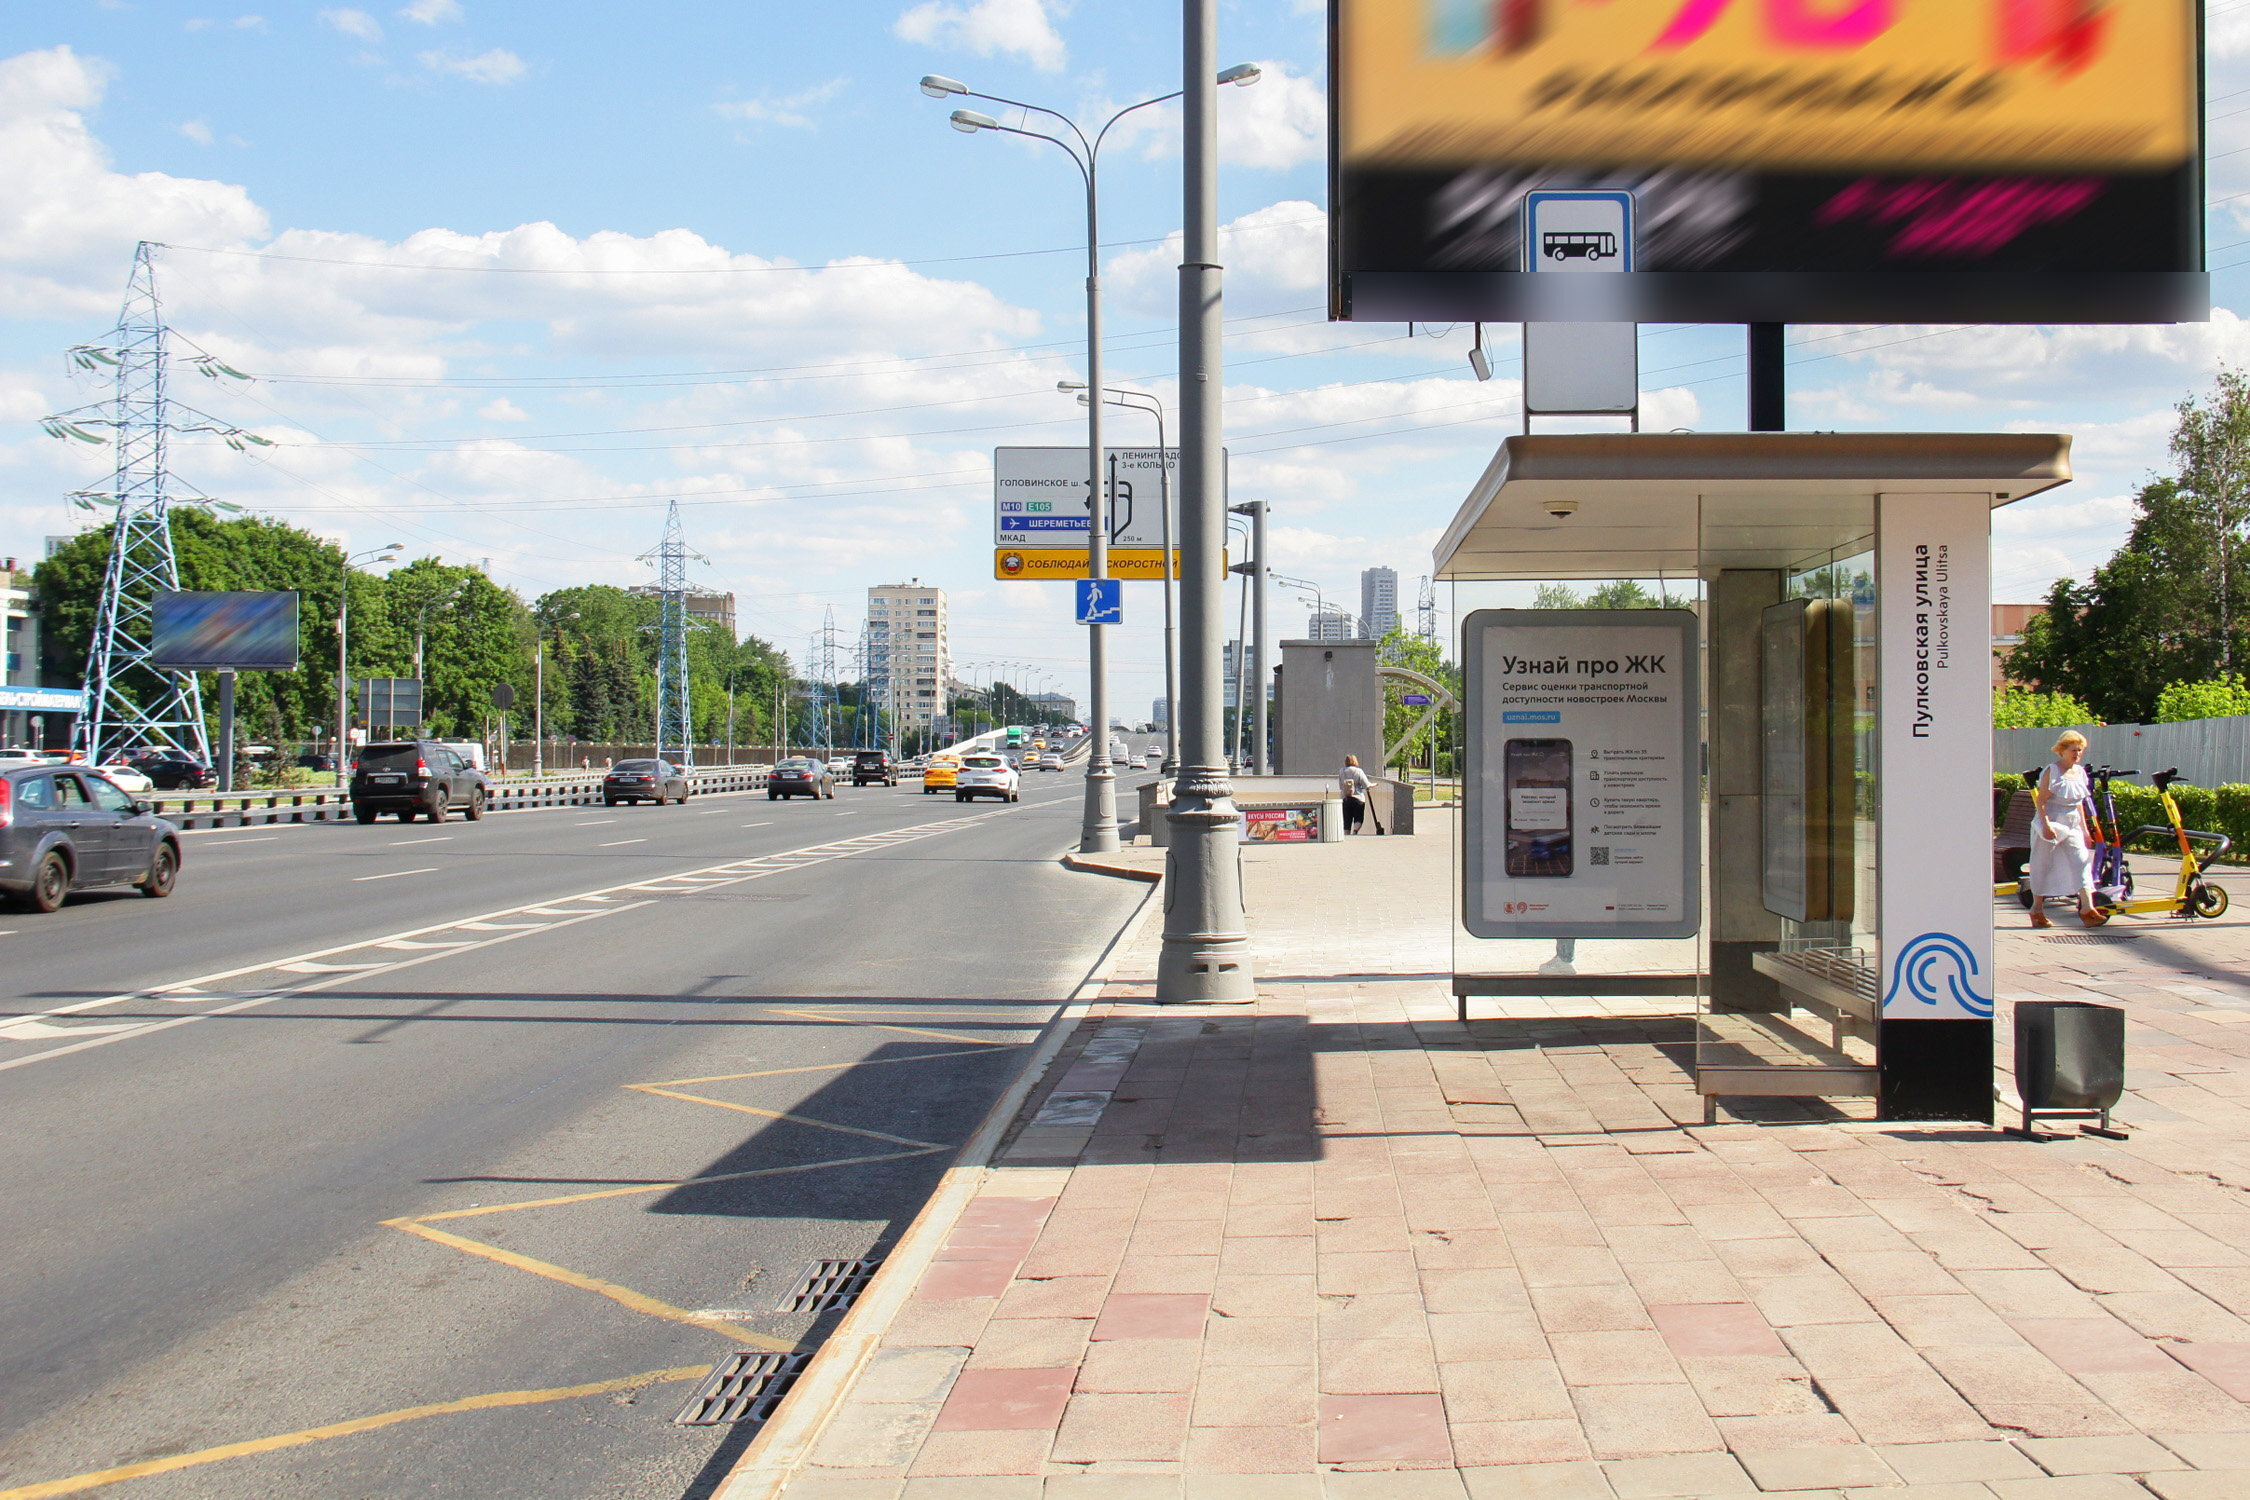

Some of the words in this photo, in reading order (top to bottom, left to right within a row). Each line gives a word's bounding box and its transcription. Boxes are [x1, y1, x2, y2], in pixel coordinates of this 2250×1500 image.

[1000, 479, 1068, 487] ГОЛОВИНСКОЕ
[1000, 534, 1026, 542] МКАД
[1027, 559, 1090, 570] СОБЛЮДАЙ
[1936, 544, 1949, 582] Ulitsa
[1915, 544, 1932, 607] улица
[1936, 586, 1951, 669] Pulkovskaya
[1502, 655, 1569, 675] Узнай
[1576, 660, 1619, 678] про
[1624, 655, 1667, 674] ЖК
[1912, 613, 1933, 738] Пулковская
[1502, 682, 1539, 693] Сервис
[1540, 684, 1577, 692] оценки
[1580, 682, 1648, 692] транспортной
[1502, 696, 1564, 705] доступности
[1566, 696, 1624, 705] новостроек
[1626, 694, 1668, 703] Москвы
